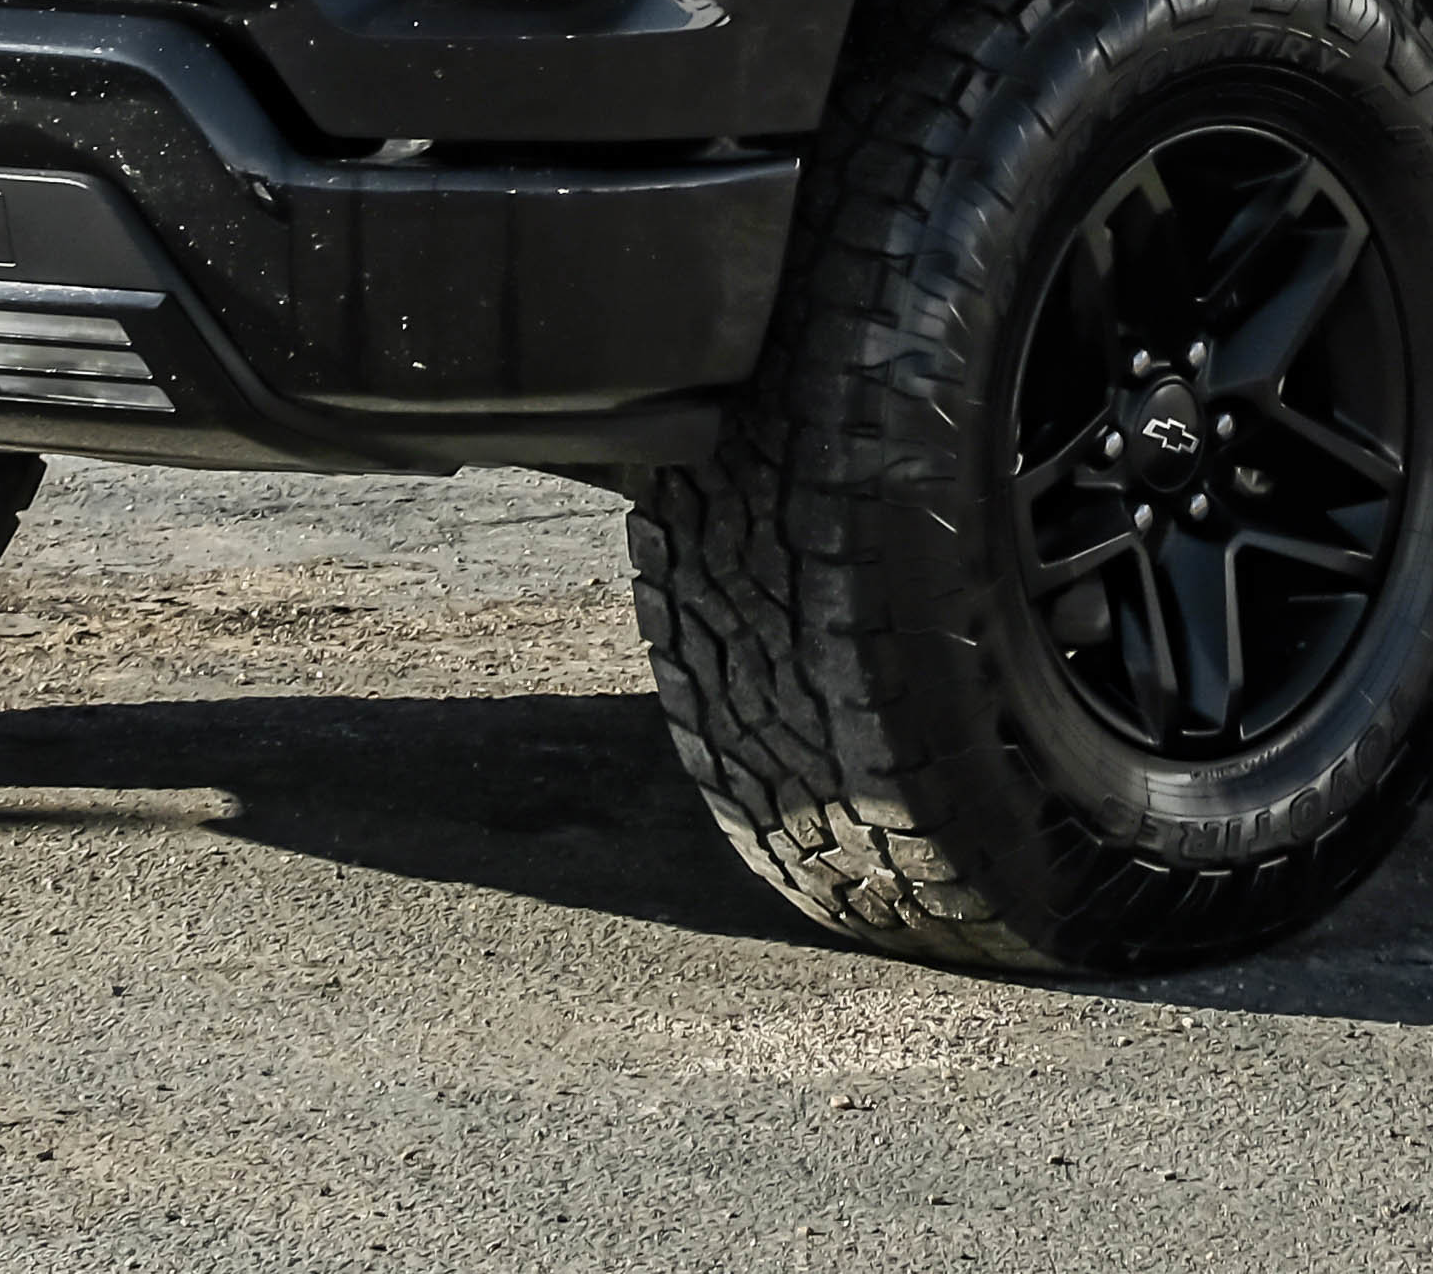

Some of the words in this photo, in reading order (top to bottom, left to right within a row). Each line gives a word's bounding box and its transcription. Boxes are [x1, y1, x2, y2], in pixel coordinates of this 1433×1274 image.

[1106, 28, 1343, 121] COUNTRY
[1288, 680, 1417, 838] TOYO
[1099, 794, 1273, 862] TIRES
